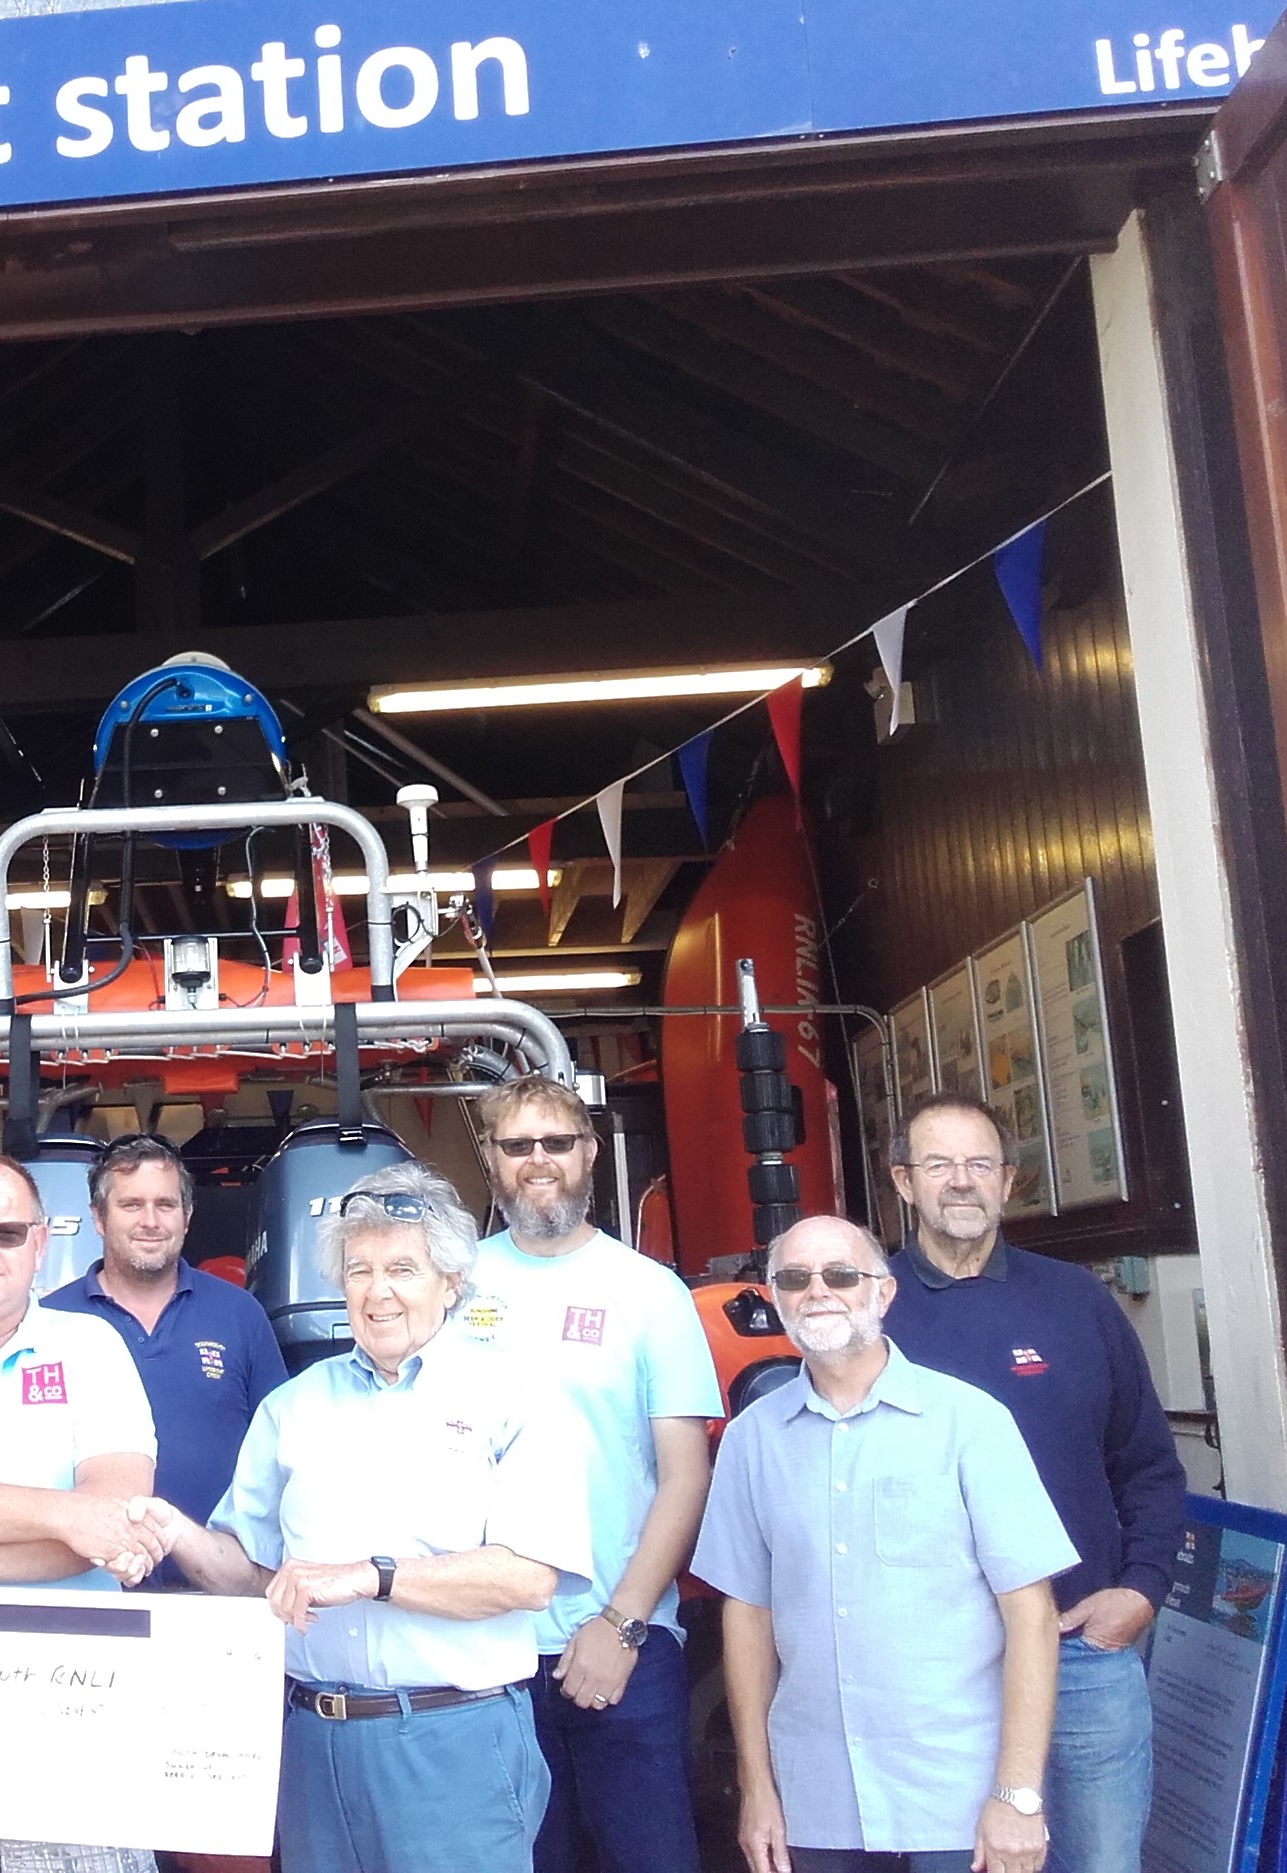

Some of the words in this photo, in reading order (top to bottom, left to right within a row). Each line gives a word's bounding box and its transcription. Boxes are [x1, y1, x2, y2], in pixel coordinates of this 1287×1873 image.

[55, 24, 531, 159] station
[570, 1308, 603, 1329] TH
[26, 1365, 60, 1385] TH
[27, 1384, 44, 1402] &
